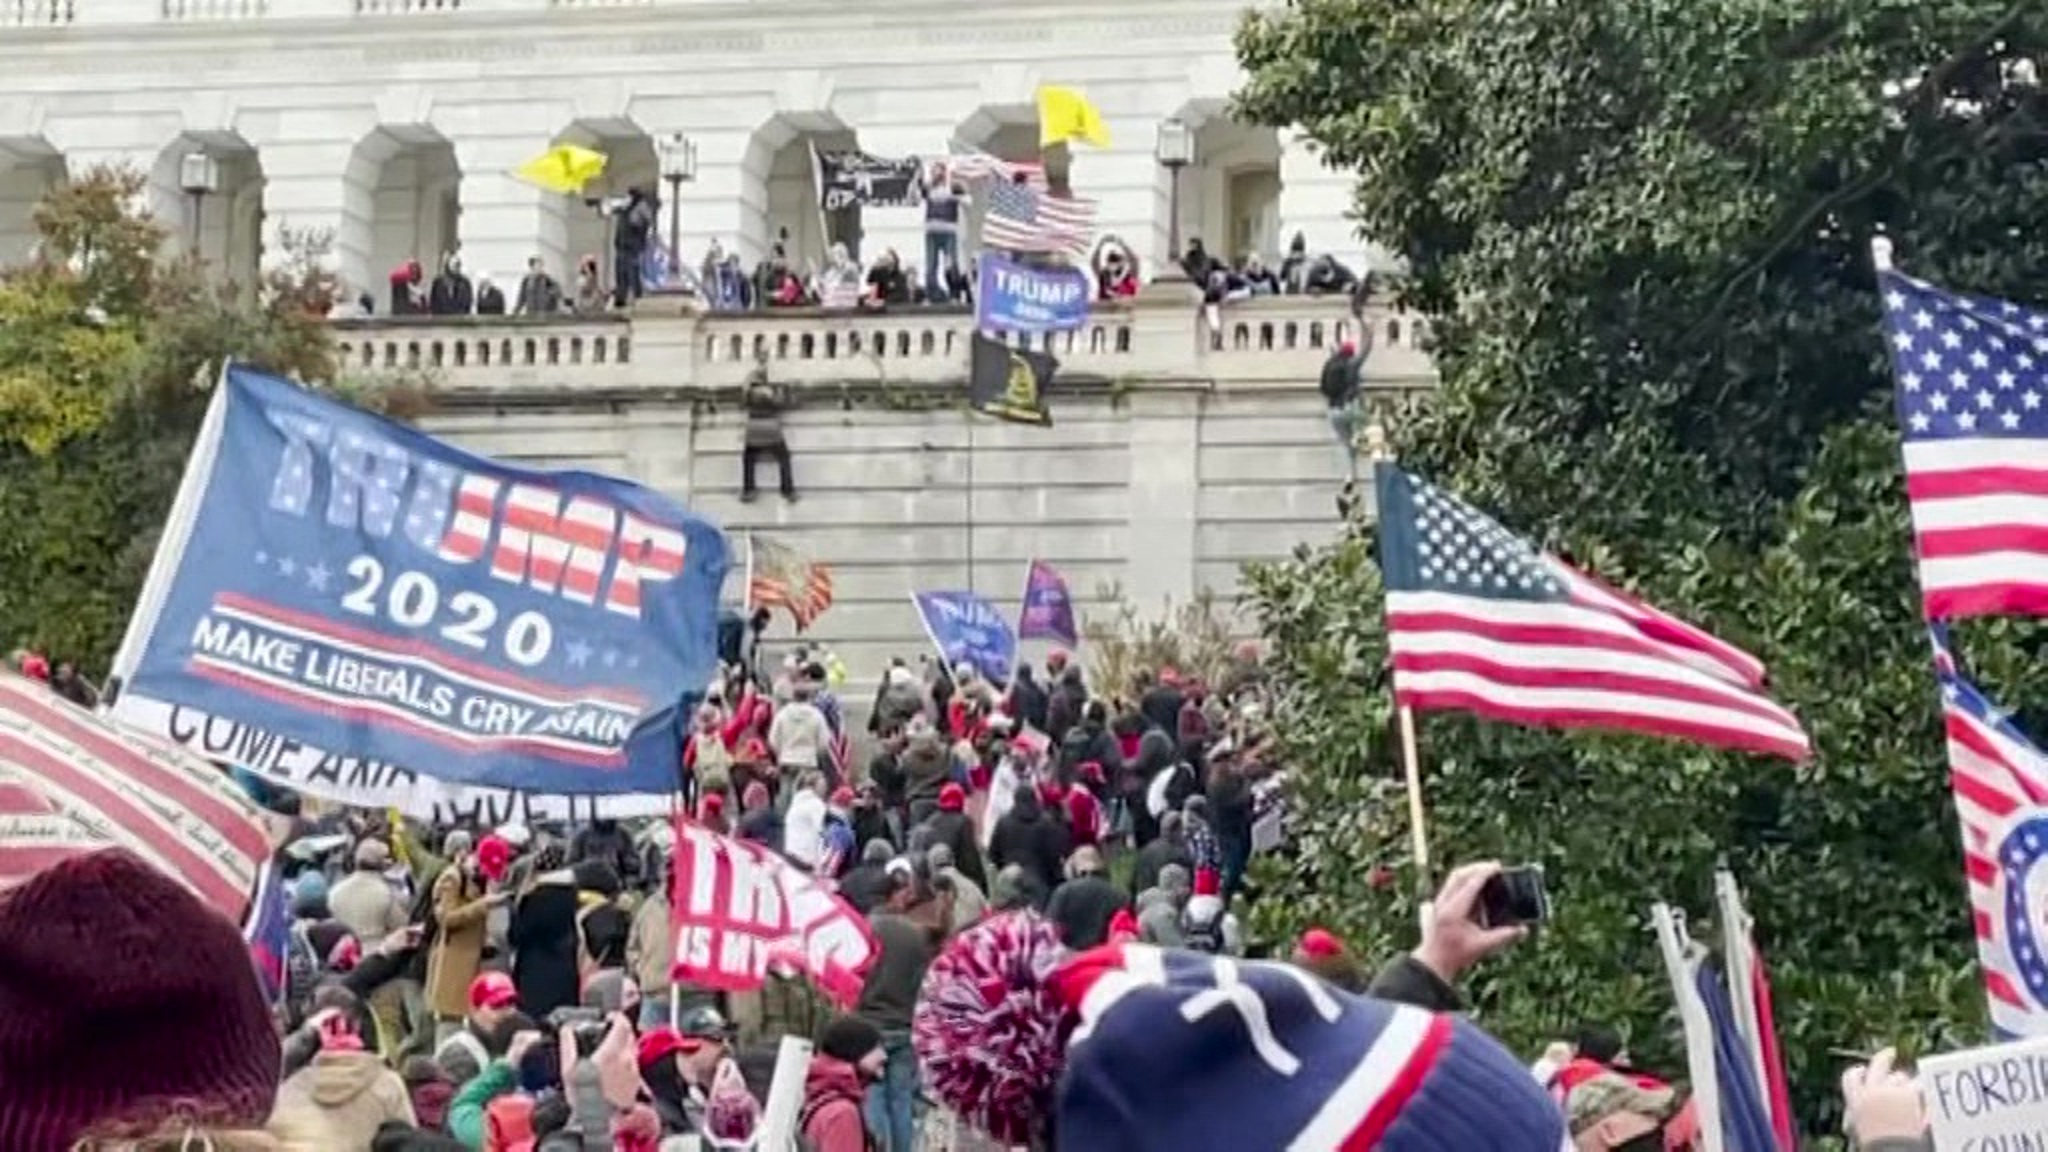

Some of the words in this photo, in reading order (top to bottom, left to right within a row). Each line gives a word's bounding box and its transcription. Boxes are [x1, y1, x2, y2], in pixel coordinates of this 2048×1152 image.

[991, 268, 1082, 304] TRUMP
[266, 406, 688, 620] TRUMP
[340, 553, 553, 667] 2020
[929, 597, 1004, 634] TRUM
[191, 616, 303, 676] MAKE
[460, 695, 535, 736] CRY
[169, 703, 302, 777] COME
[675, 922, 712, 969] IS
